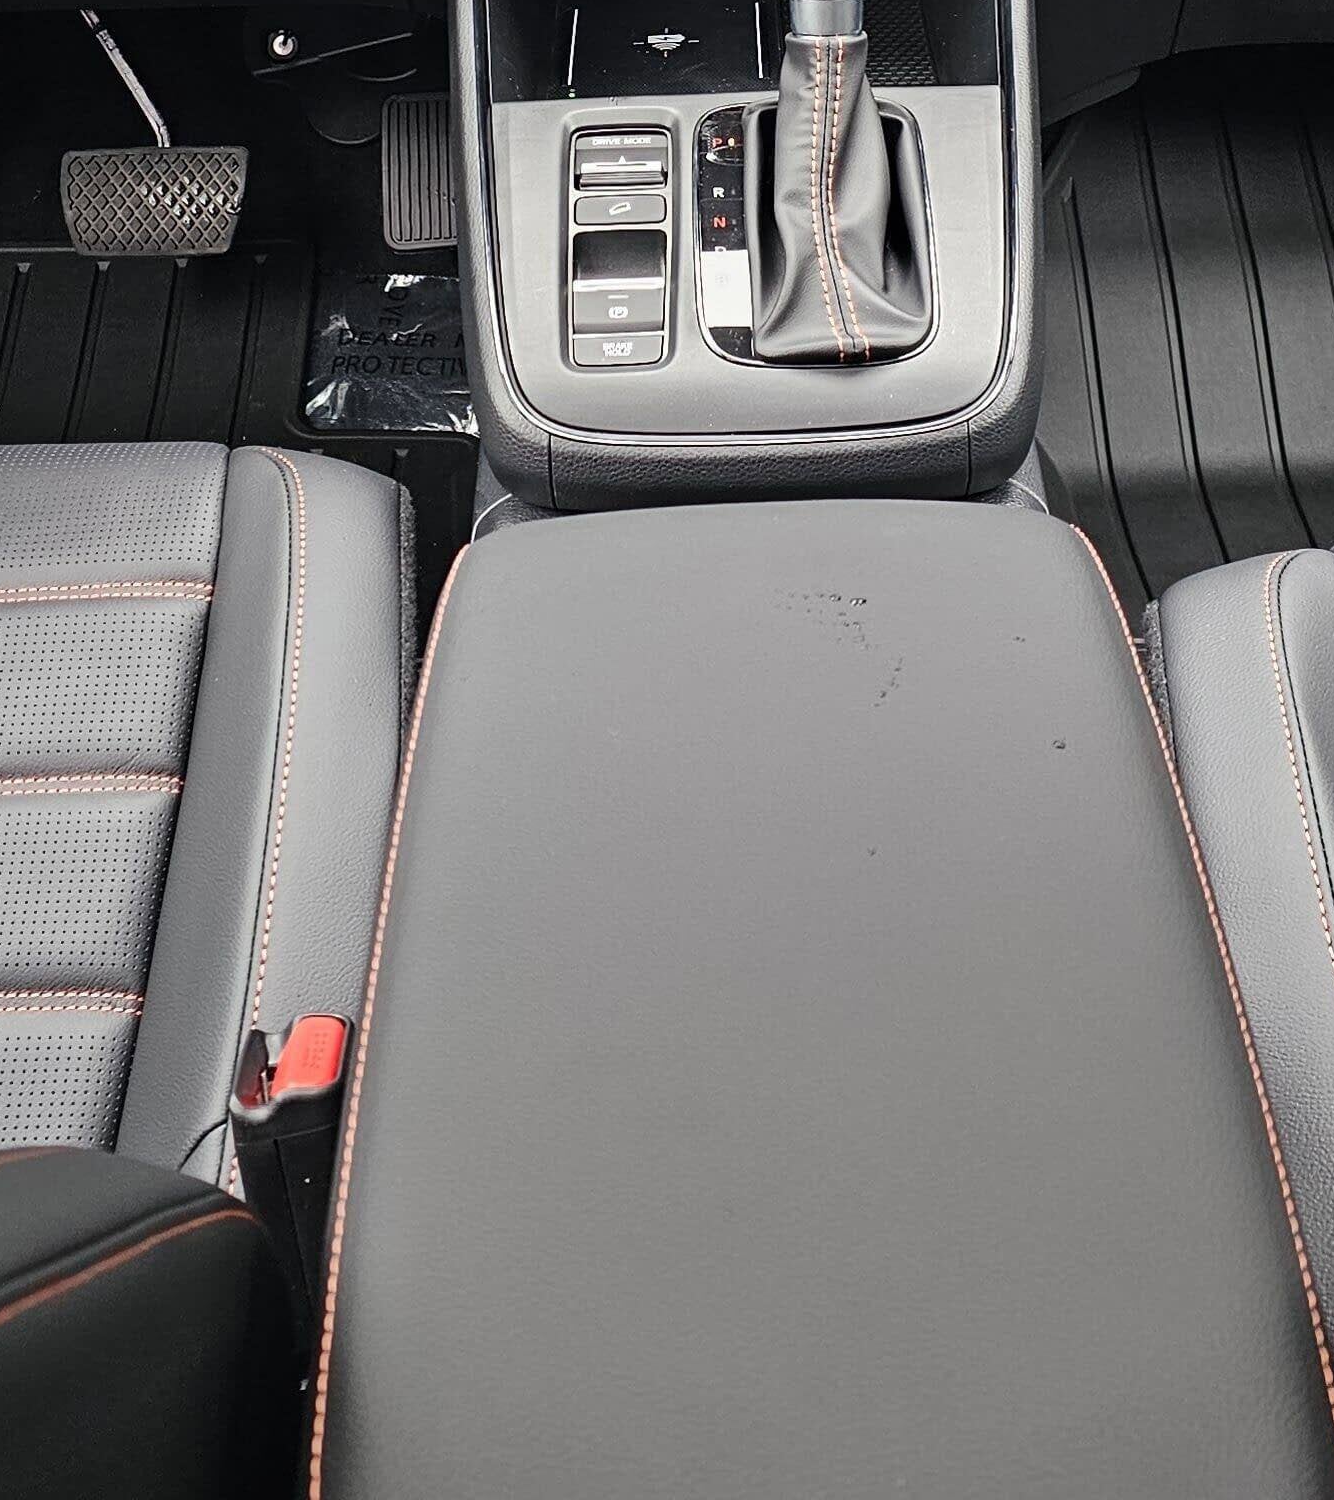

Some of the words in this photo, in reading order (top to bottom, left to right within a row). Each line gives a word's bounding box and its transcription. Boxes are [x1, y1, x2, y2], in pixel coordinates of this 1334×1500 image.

[592, 137, 620, 146] DRIVE
[623, 137, 652, 145] MODE
[712, 138, 723, 148] P
[713, 187, 725, 198] R
[713, 216, 726, 228] N
[338, 328, 436, 347] DEALER
